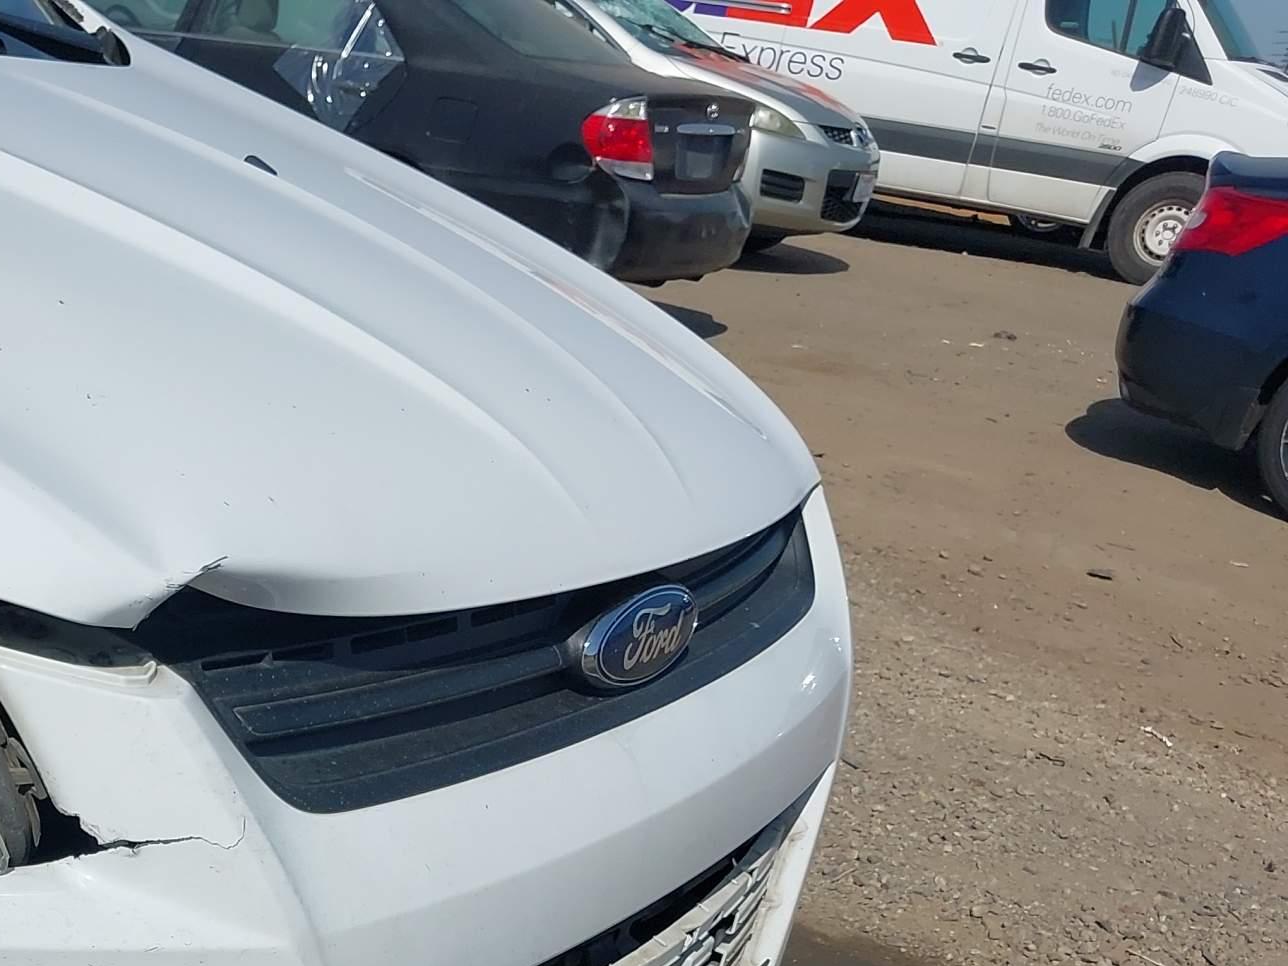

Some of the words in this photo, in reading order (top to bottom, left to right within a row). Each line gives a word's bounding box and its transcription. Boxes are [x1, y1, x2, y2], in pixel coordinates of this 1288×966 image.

[1046, 82, 1133, 113] fedex.com
[1052, 125, 1080, 137] World
[1081, 130, 1096, 140] On
[623, 602, 686, 670] Ford
